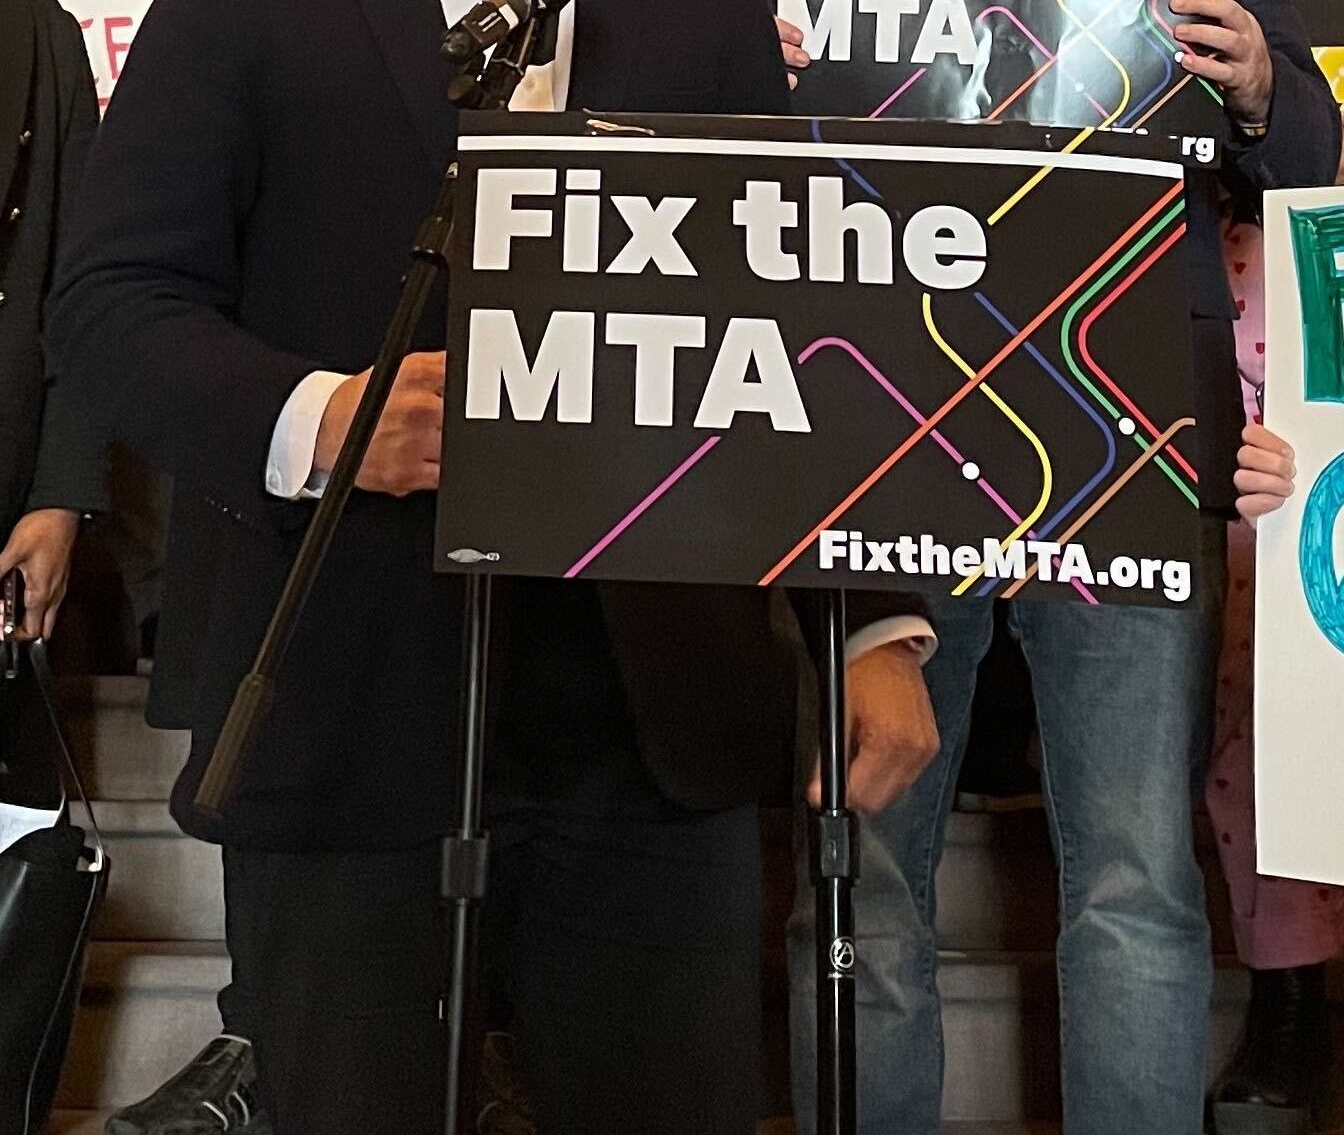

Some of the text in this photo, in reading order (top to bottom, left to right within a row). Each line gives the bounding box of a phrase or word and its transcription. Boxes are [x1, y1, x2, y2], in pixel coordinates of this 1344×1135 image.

[472, 168, 988, 291] Fix the
[465, 308, 812, 434] MTA
[819, 529, 1192, 602] FixtheMTA.org
